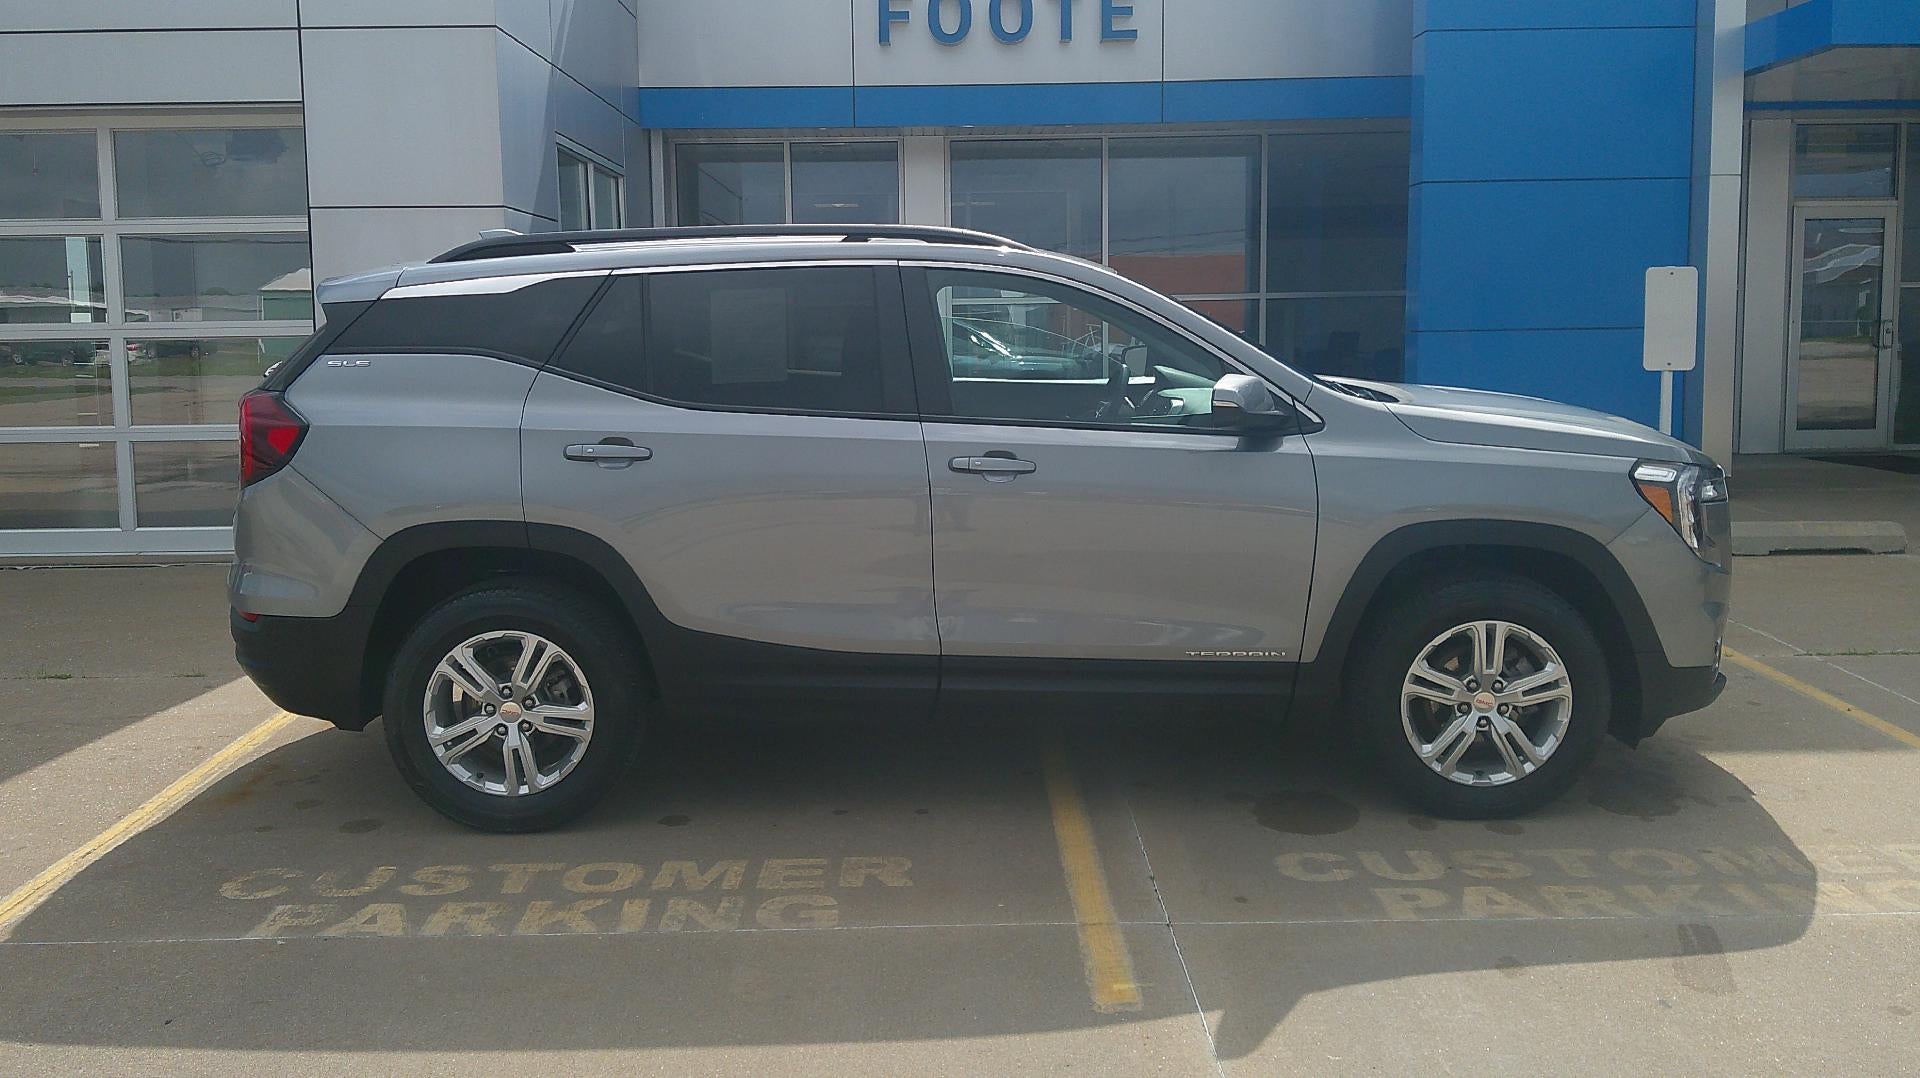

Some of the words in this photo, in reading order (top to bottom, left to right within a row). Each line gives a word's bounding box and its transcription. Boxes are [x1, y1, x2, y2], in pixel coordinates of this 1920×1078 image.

[878, 0, 1139, 46] FOOTE
[219, 856, 914, 900] CUSTOMER
[247, 894, 839, 937] PARKING
